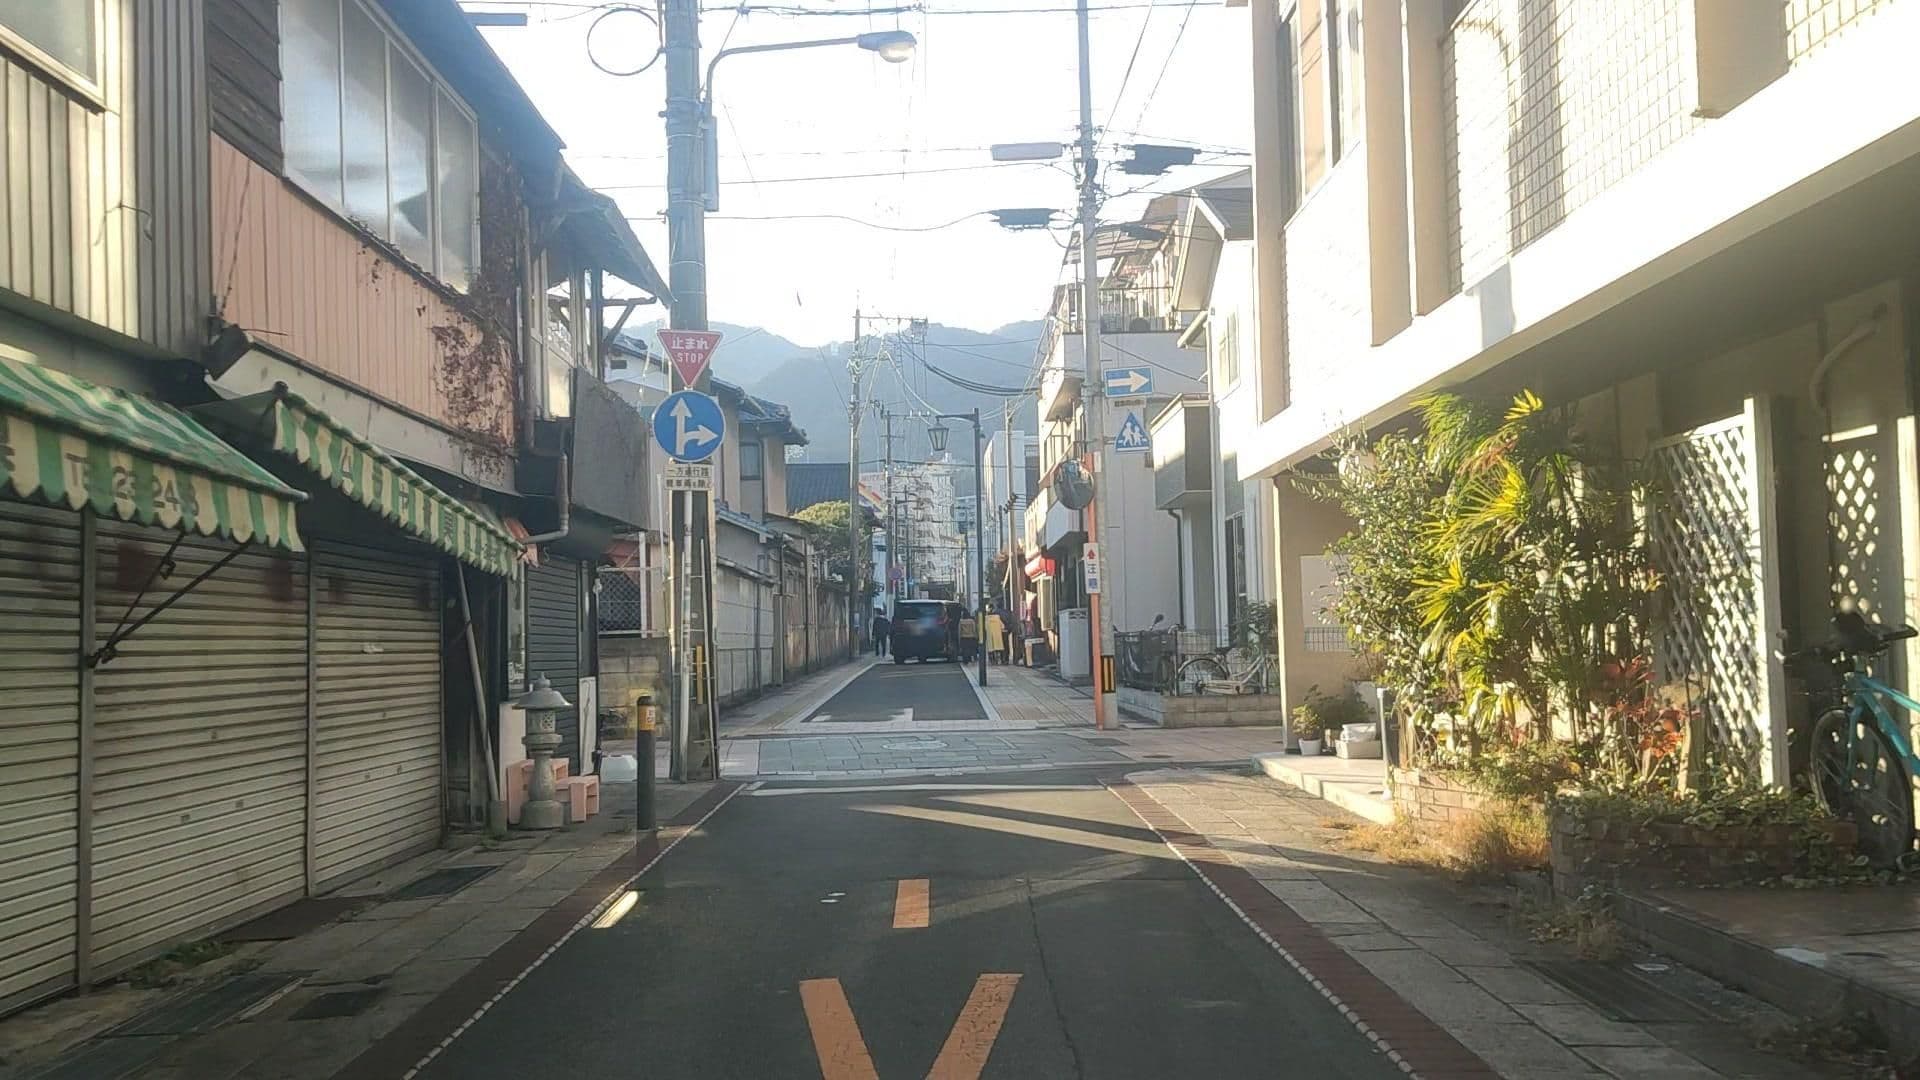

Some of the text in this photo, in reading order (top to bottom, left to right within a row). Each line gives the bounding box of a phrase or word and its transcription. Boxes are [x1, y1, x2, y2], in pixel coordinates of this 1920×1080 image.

[672, 337, 709, 350] 止まれ
[677, 352, 704, 363] STOP
